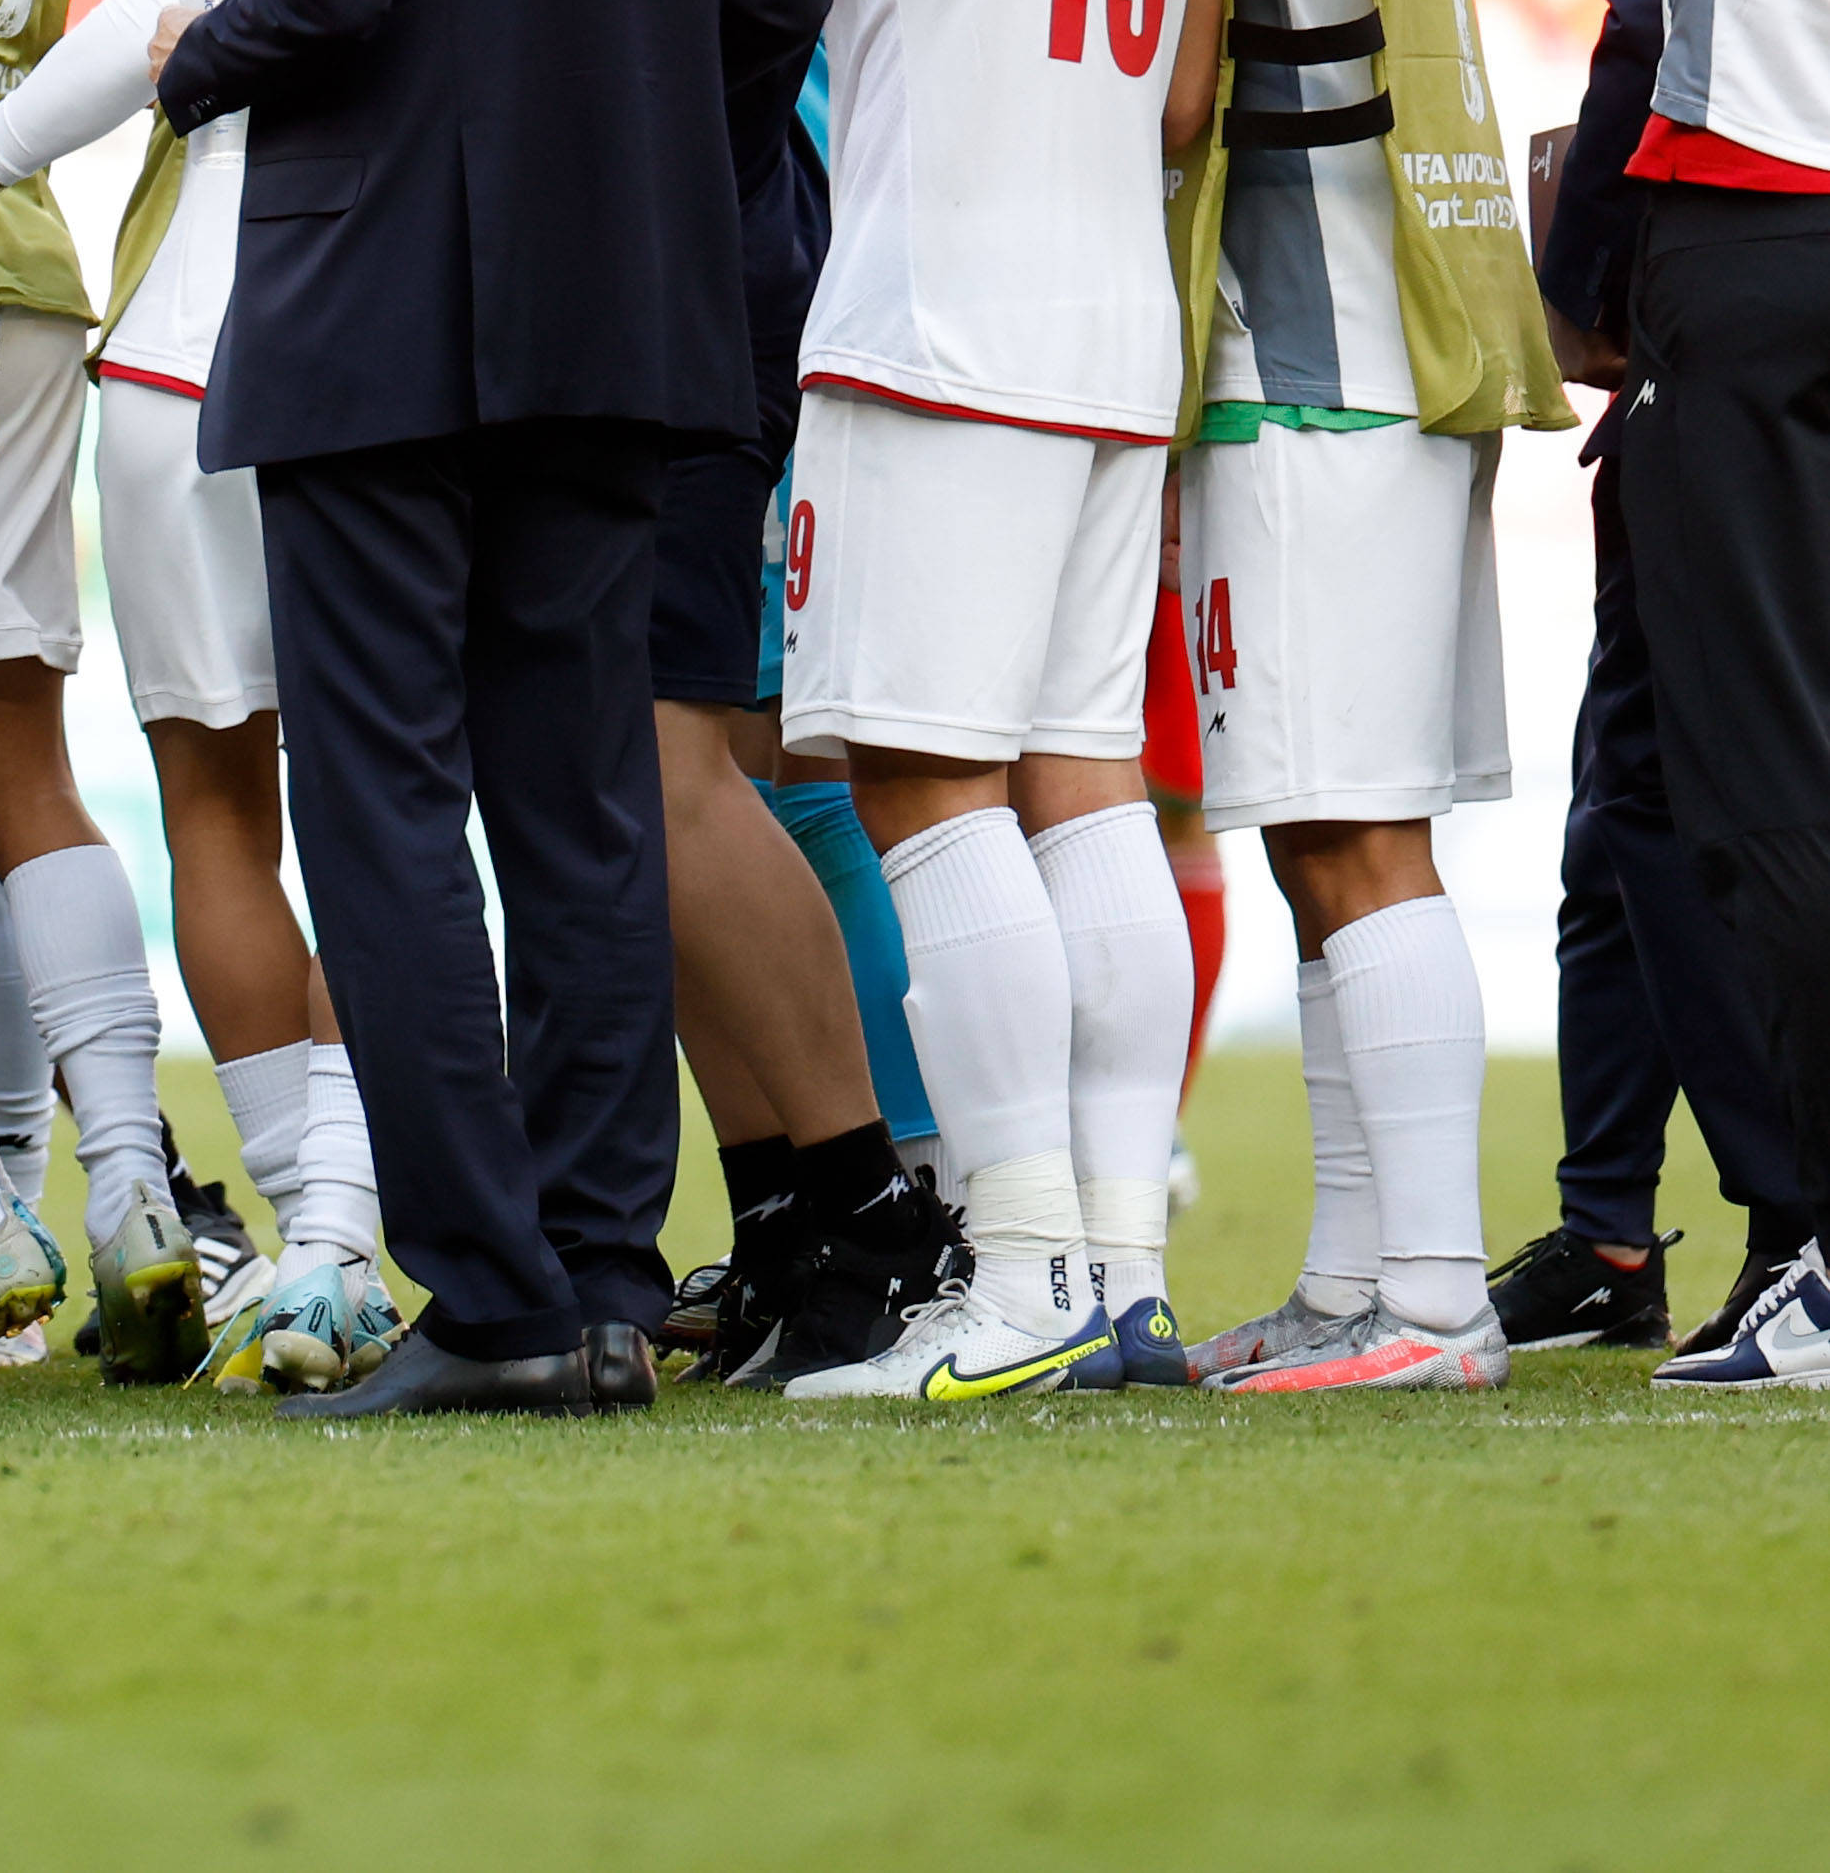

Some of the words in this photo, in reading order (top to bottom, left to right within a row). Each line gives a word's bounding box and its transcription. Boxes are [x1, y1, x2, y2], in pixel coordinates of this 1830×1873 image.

[1400, 152, 1453, 186] IFA
[786, 499, 816, 612] 9
[1195, 577, 1238, 695] 14
[1050, 1254, 1072, 1312] OCKS
[1056, 1341, 1103, 1368] TIEMPO
